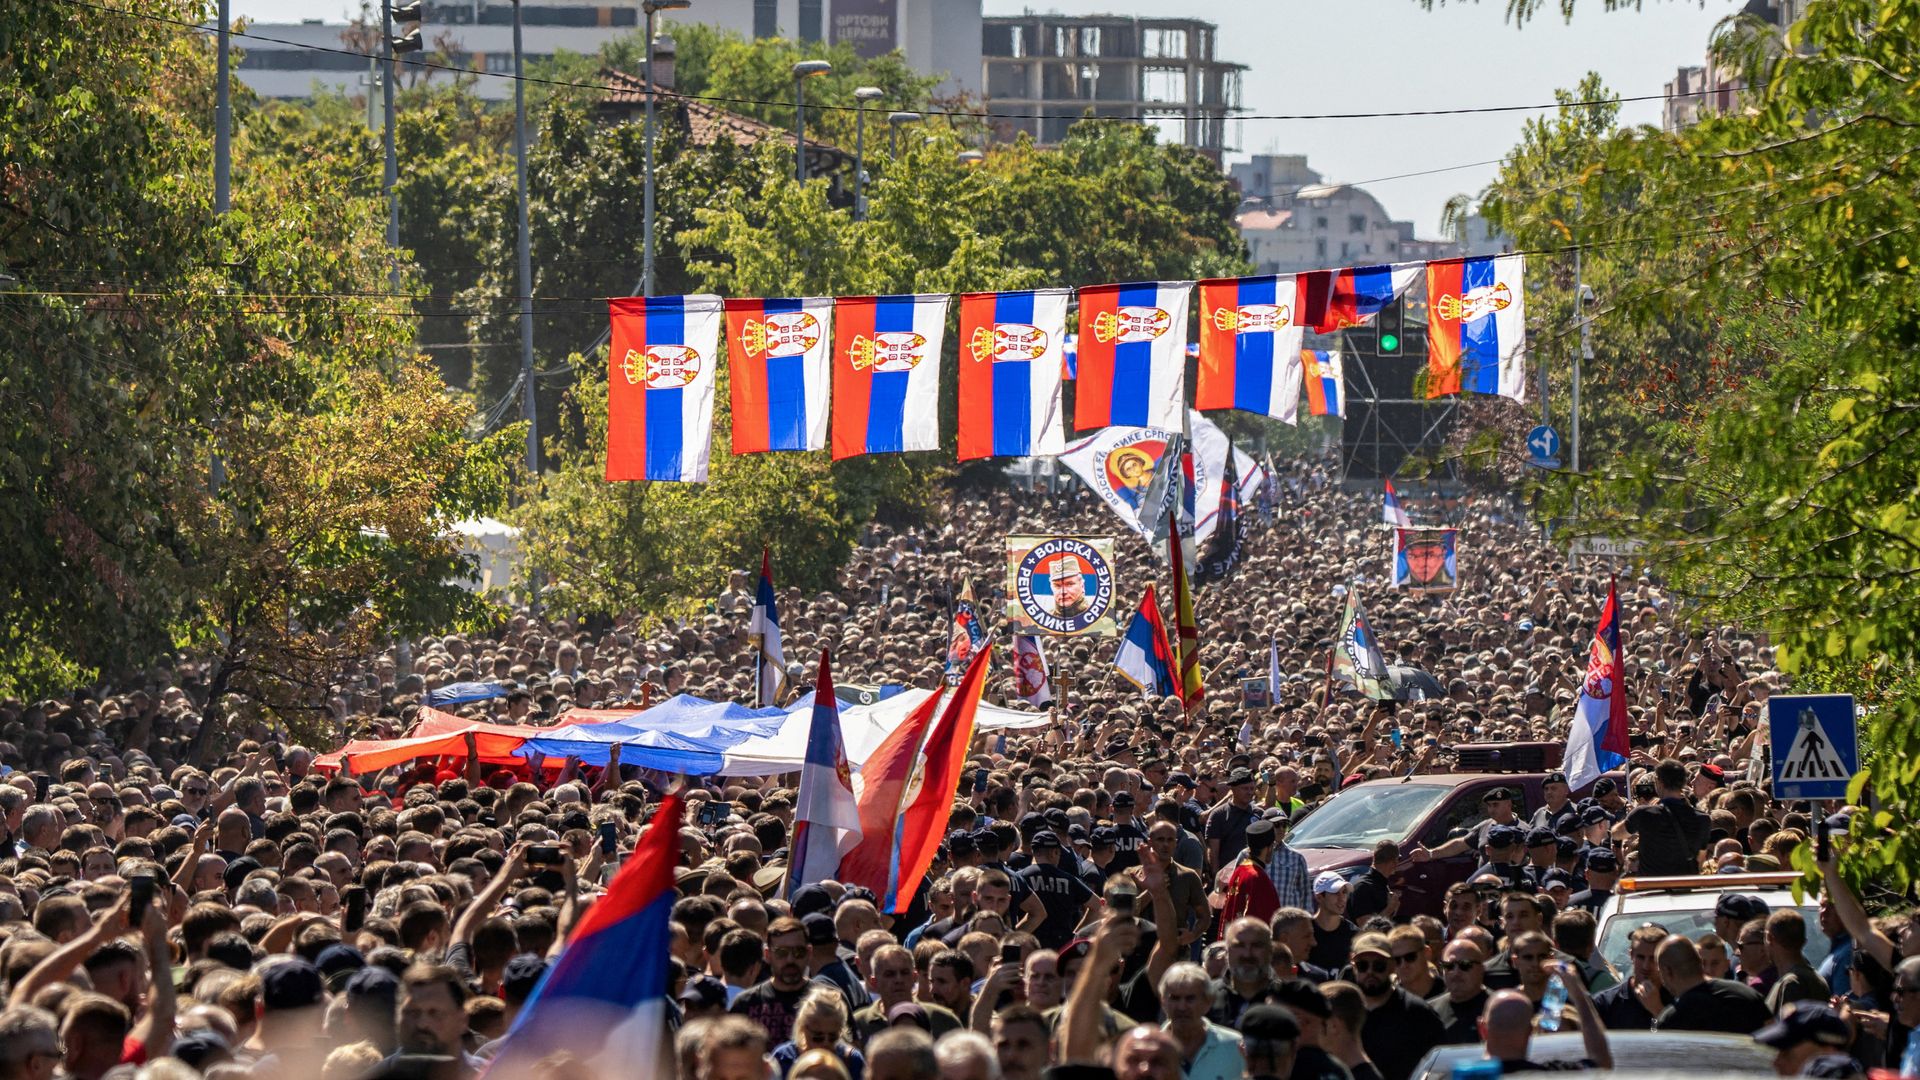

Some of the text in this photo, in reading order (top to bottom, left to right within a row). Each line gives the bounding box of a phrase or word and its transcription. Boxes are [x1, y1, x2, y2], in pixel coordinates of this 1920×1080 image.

[1034, 540, 1092, 559] ВОЈСКА
[1018, 565, 1111, 631] РЕПУБЛИКЕ СРПСКЕ
[1029, 875, 1070, 895] ИЈП
